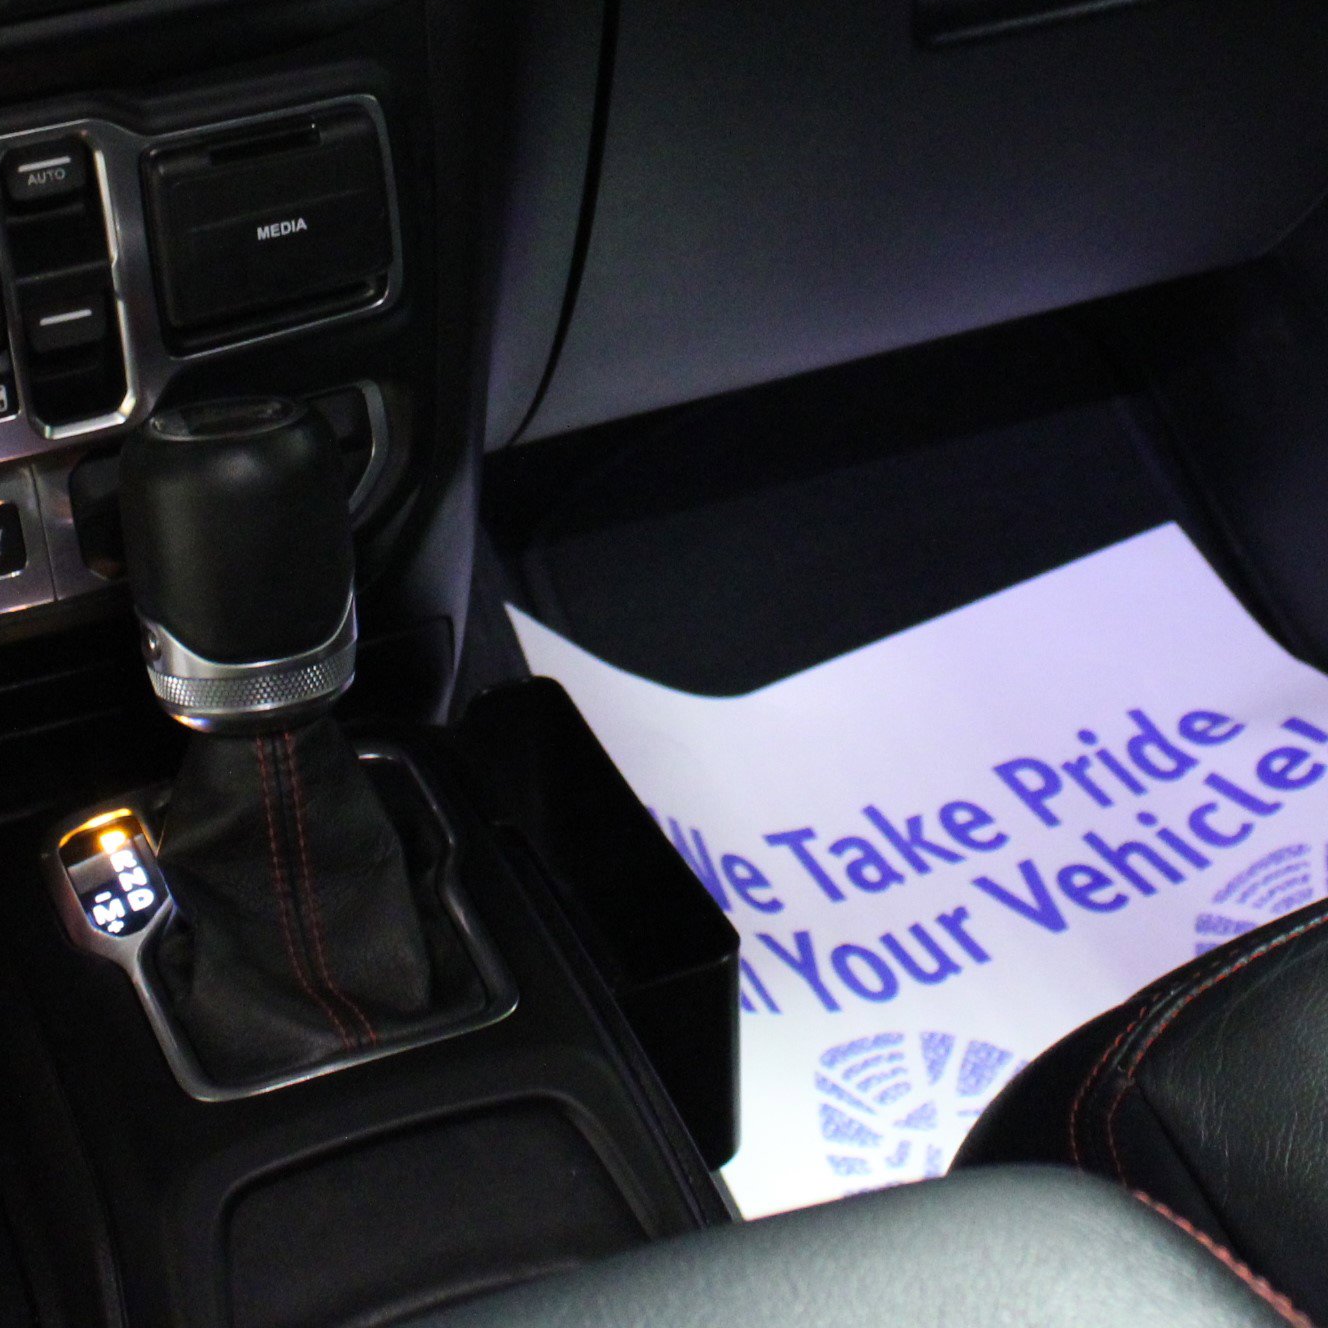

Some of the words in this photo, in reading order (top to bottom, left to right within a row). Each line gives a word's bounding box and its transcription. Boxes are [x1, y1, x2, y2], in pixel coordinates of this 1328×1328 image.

[28, 168, 66, 187] AUTO
[256, 216, 309, 241] MEDIA
[763, 799, 1010, 904] Take
[992, 708, 1247, 829] Pride
[110, 849, 137, 873] R
[118, 866, 148, 892] N
[93, 898, 126, 926] M
[127, 888, 154, 912] D
[757, 905, 992, 1015] Your
